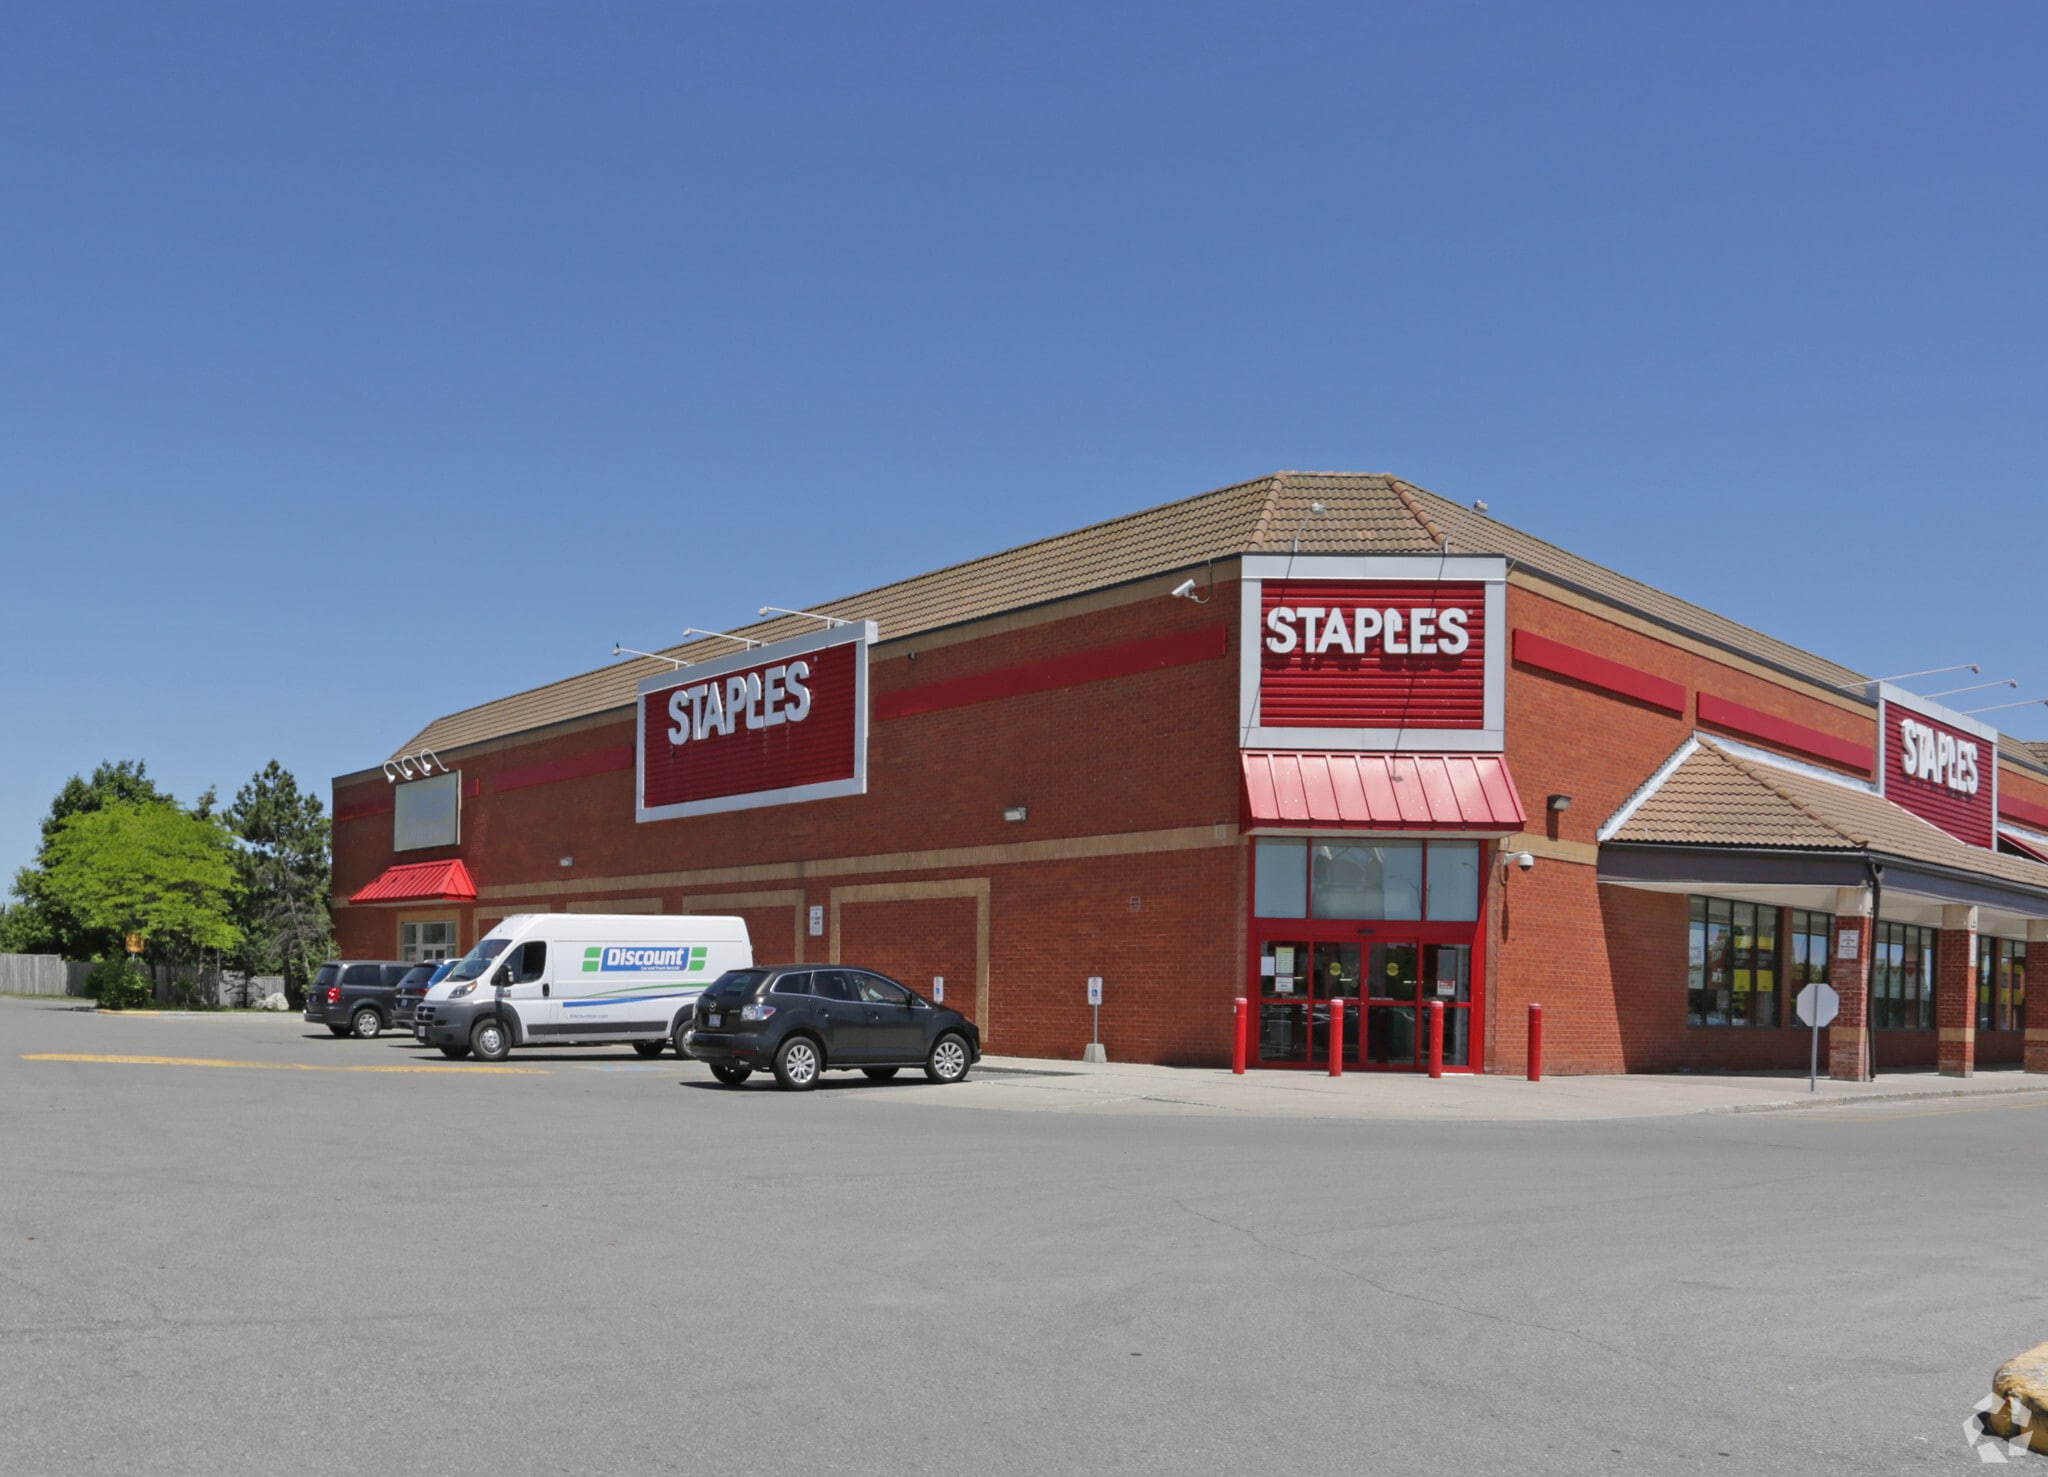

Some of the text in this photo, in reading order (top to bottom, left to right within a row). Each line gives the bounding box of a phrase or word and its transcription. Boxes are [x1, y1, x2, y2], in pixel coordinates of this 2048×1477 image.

[1266, 606, 1470, 655] STAPLES
[667, 660, 812, 745] STAPLES
[1901, 718, 1979, 795] STAPLES
[607, 948, 684, 966] Discount
